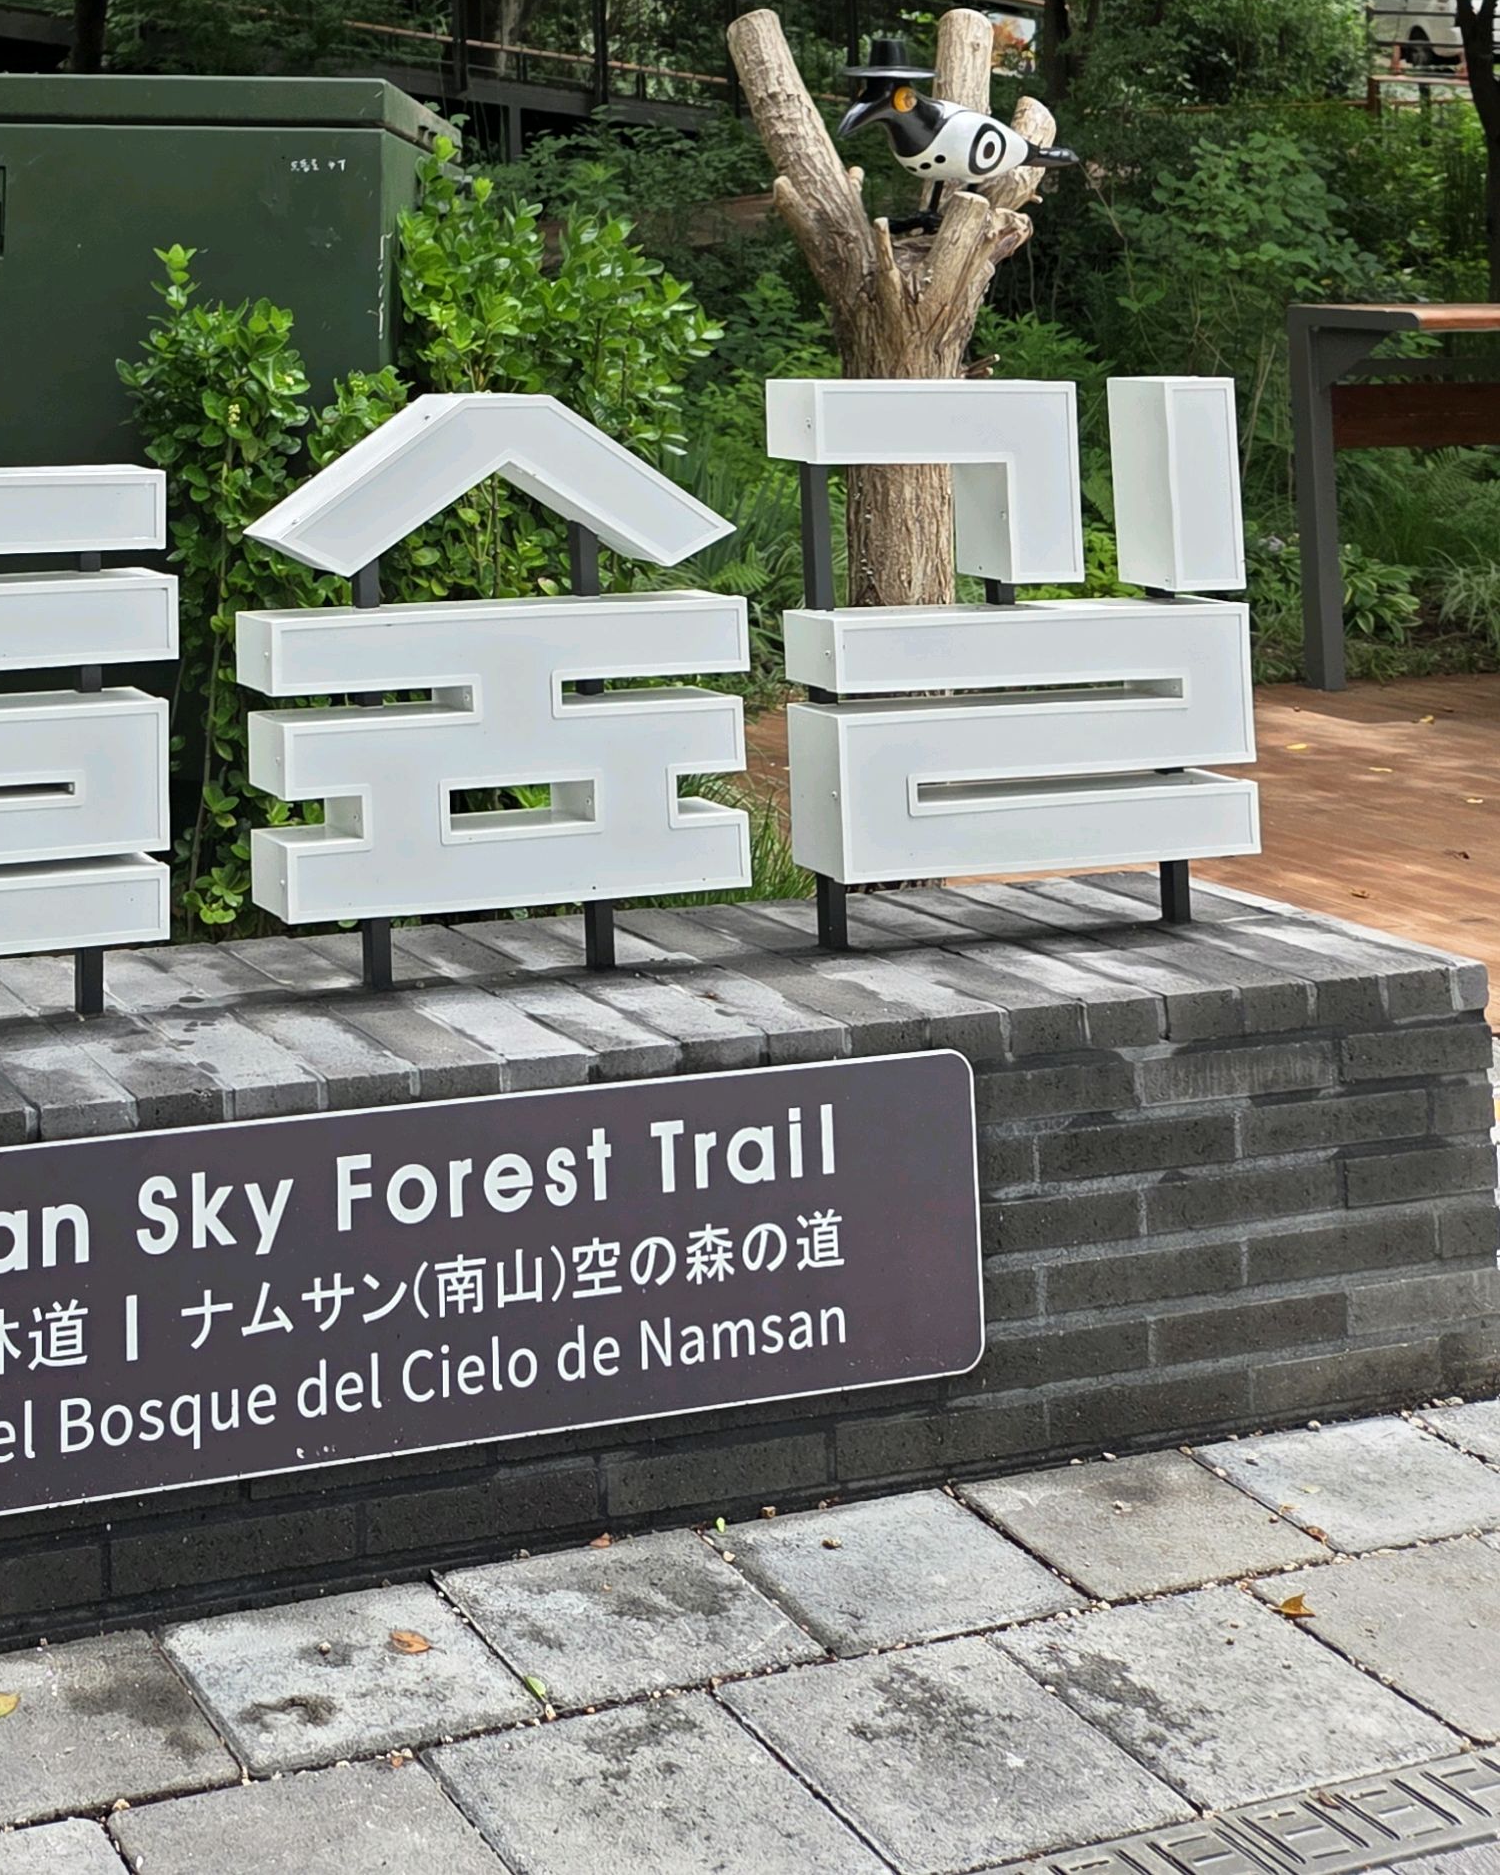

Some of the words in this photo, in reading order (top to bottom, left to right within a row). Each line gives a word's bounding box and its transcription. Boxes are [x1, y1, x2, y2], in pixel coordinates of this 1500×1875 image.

[135, 1170, 295, 1256] Sky
[335, 1127, 613, 1232] Forest
[649, 1103, 837, 1194] Trail
[179, 1208, 846, 1350] ナムサン(南山)空の森の道
[59, 1383, 278, 1453] Bosque
[296, 1352, 384, 1419] del
[401, 1335, 539, 1403] Cielo
[556, 1324, 622, 1383] de
[639, 1305, 847, 1372] Namsan
